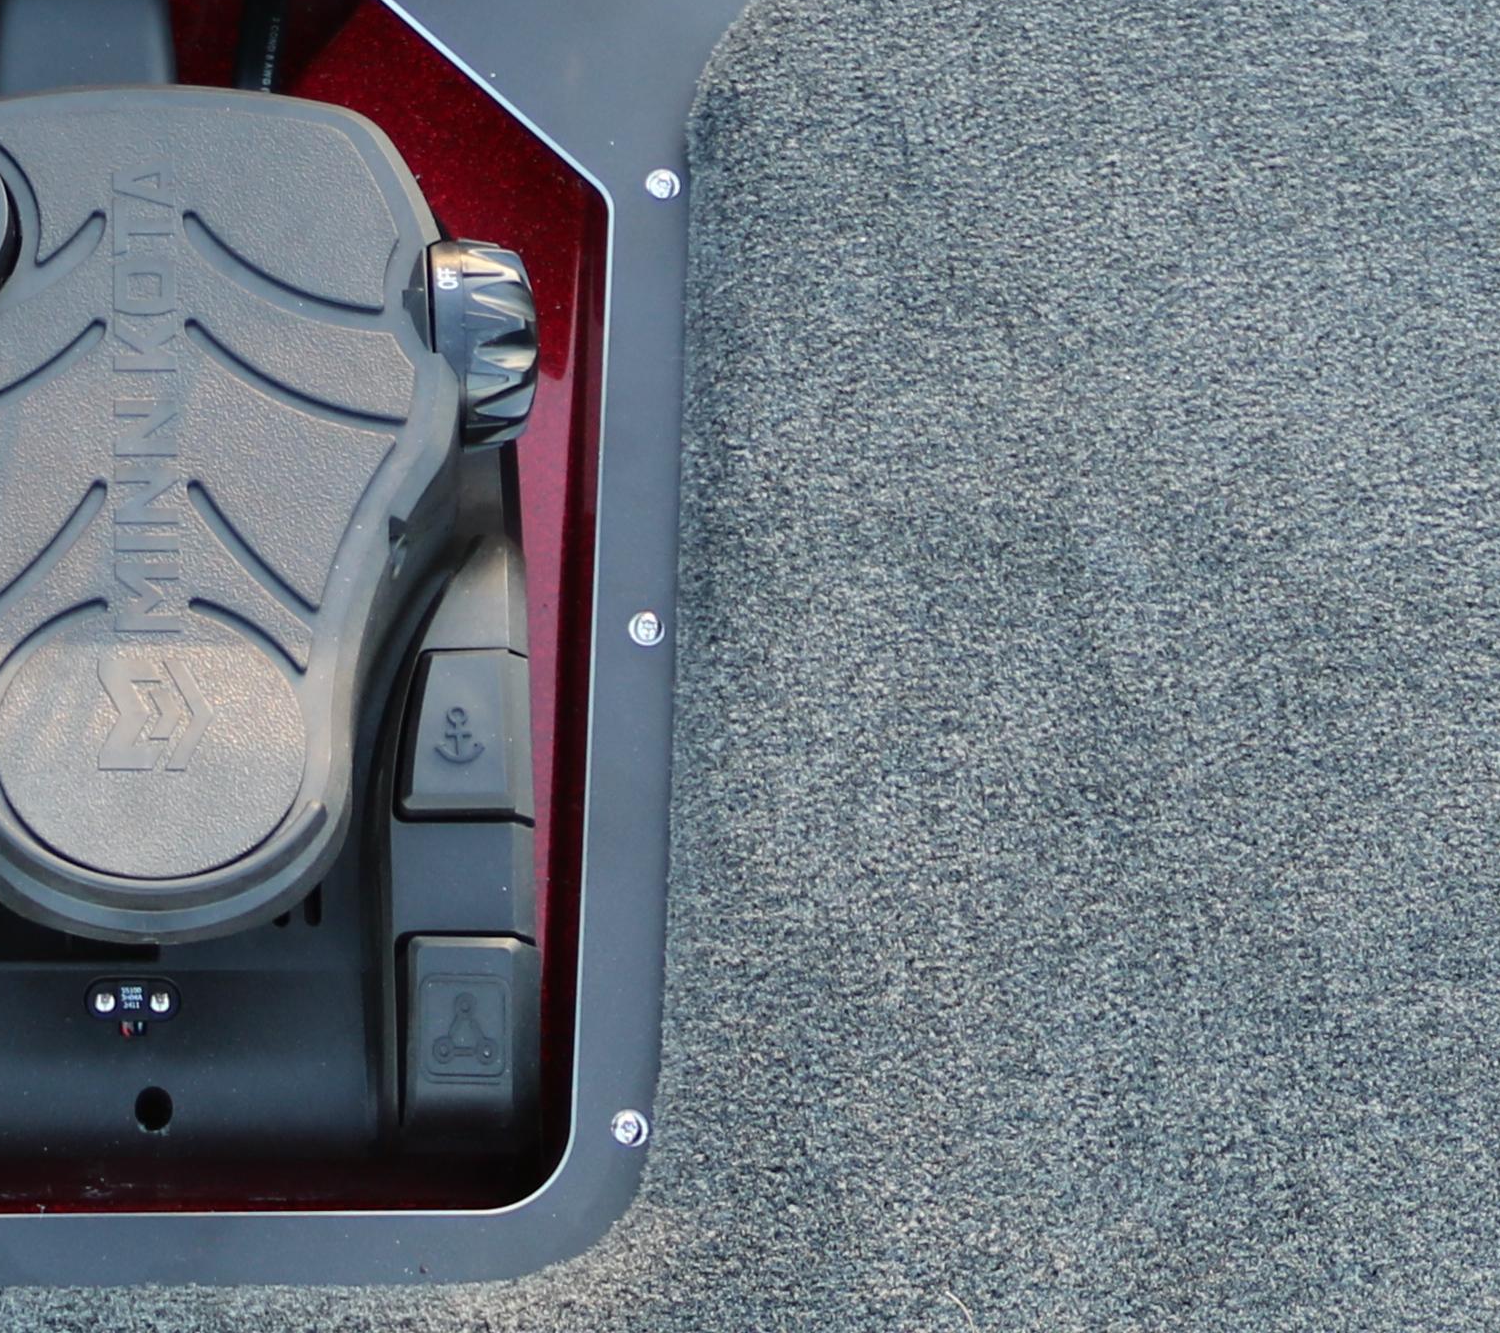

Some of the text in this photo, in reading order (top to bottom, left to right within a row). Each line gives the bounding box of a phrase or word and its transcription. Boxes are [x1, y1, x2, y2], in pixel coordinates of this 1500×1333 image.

[262, 62, 274, 86] AWG
[436, 266, 459, 290] OFF
[111, 156, 182, 633] MINN KOTA
